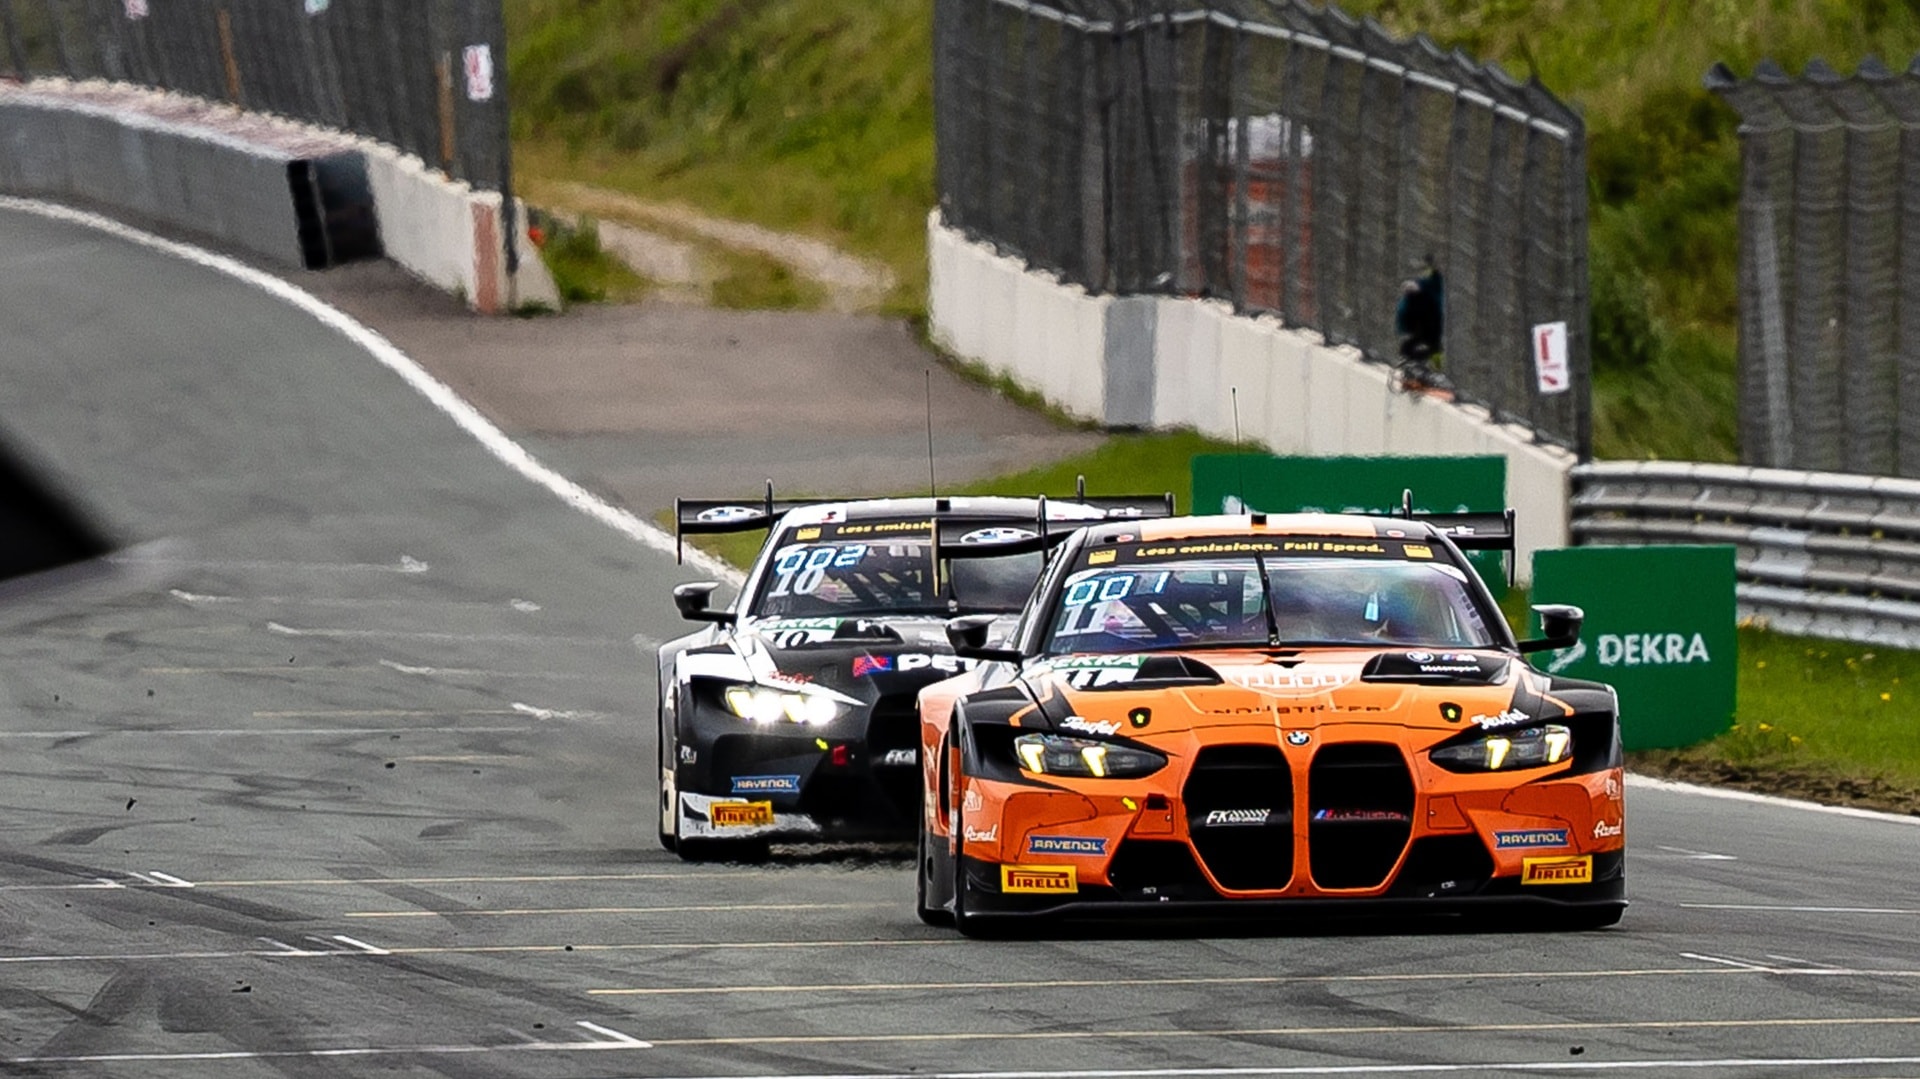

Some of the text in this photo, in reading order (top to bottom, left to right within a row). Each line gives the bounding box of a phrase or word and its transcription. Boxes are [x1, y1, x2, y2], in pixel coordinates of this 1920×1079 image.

[1136, 542, 1386, 557] Less emissions. Full Speed.
[768, 568, 826, 598] 10
[1055, 602, 1109, 637] 11
[1597, 632, 1711, 666] DEKRA
[1034, 839, 1101, 851] RAVENOL
[1501, 832, 1565, 845] RAVENOL
[1528, 860, 1587, 880] PIRELLI
[1007, 871, 1070, 889] PIRELLI
